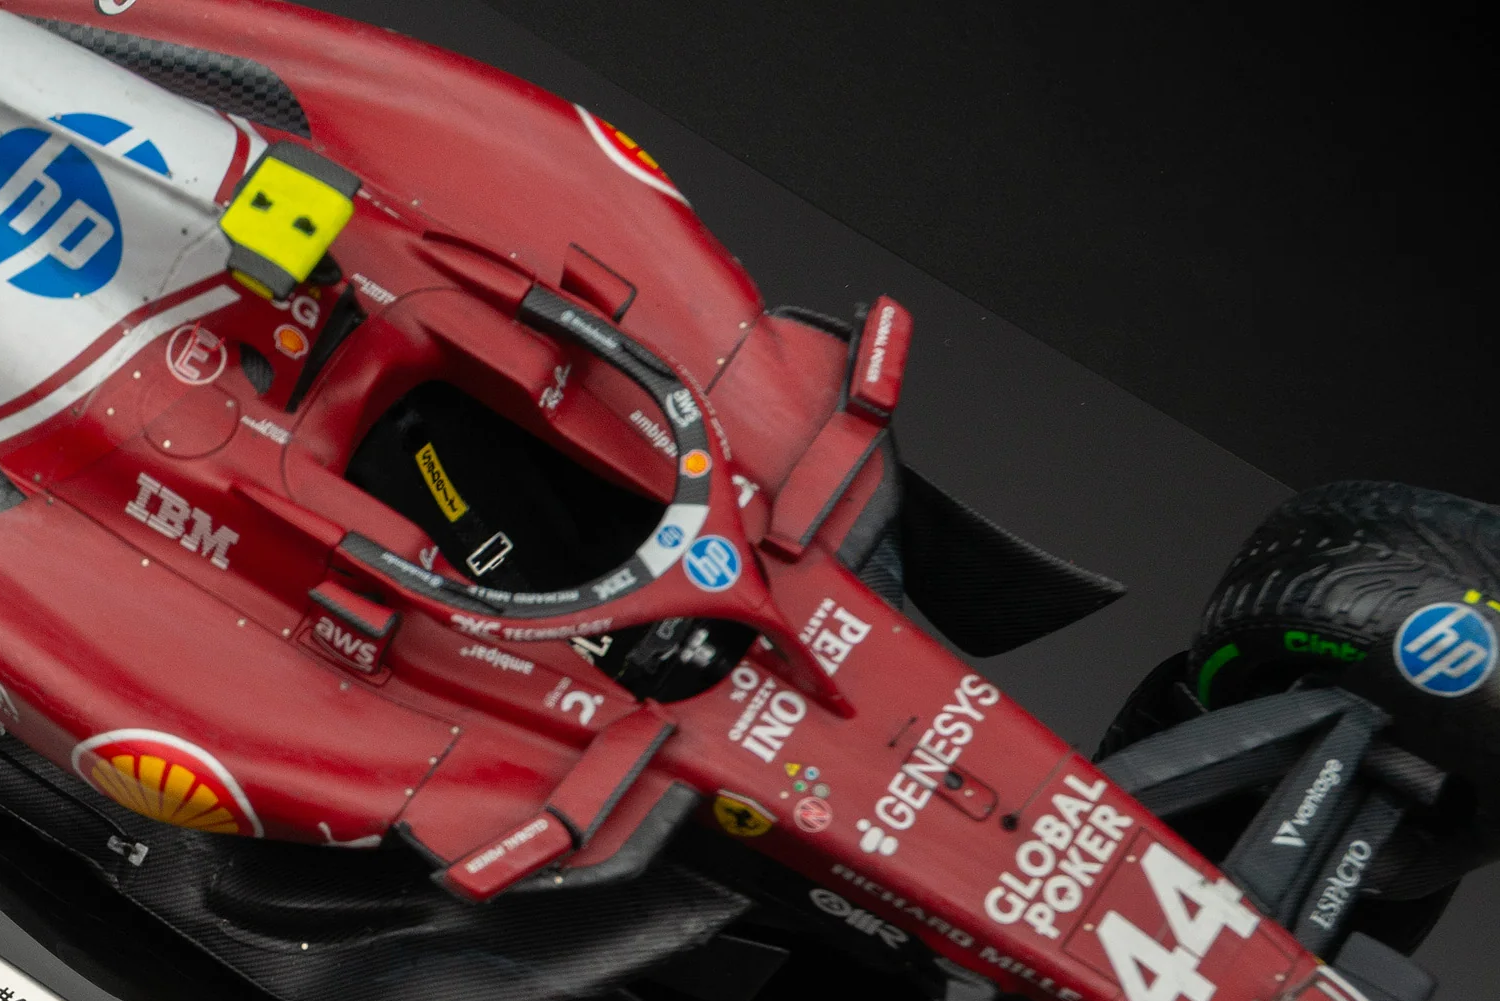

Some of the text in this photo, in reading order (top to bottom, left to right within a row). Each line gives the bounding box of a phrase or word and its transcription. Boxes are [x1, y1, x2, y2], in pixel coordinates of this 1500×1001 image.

[124, 472, 240, 570] IBM
[687, 538, 738, 589] hp
[314, 616, 379, 667] aws
[1397, 605, 1495, 692] hp
[875, 673, 1001, 831] GENESYS
[983, 774, 1107, 925] GLOBAL
[1023, 804, 1135, 940] POKER
